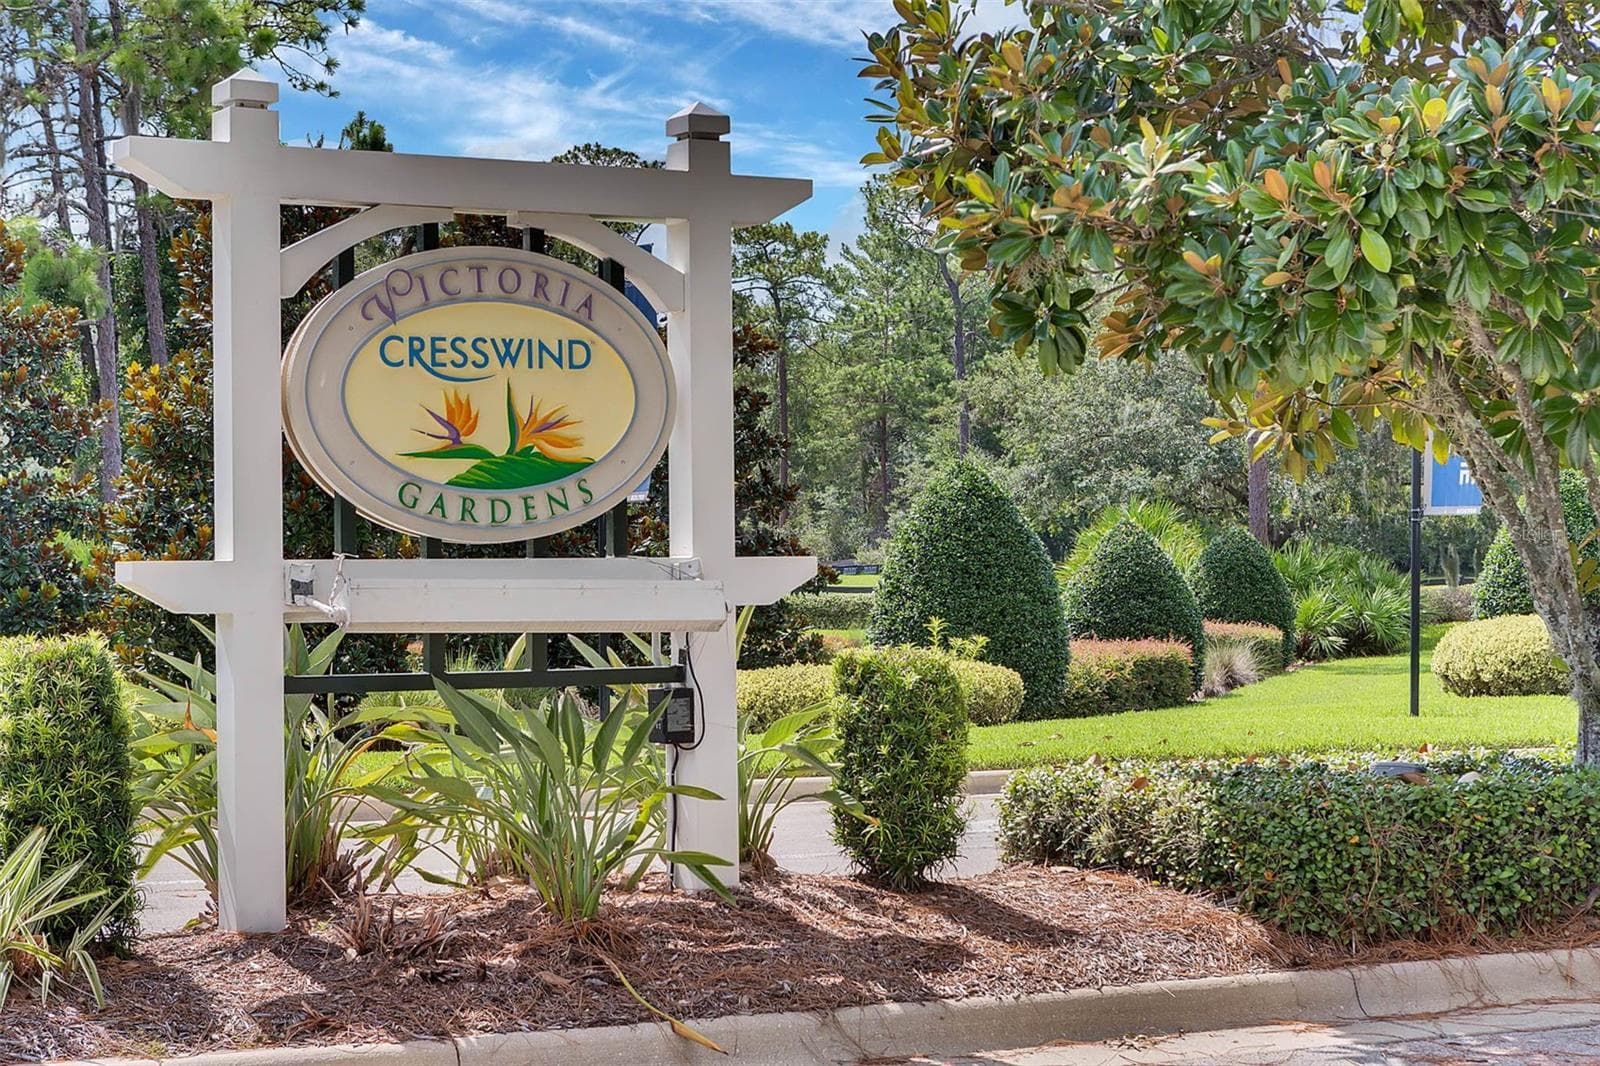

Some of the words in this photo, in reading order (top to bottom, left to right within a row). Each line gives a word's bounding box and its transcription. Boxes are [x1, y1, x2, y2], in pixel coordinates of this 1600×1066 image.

[361, 268, 594, 325] VICTORIA
[379, 335, 592, 382] CRESSWIND
[398, 480, 594, 525] GARDENS
